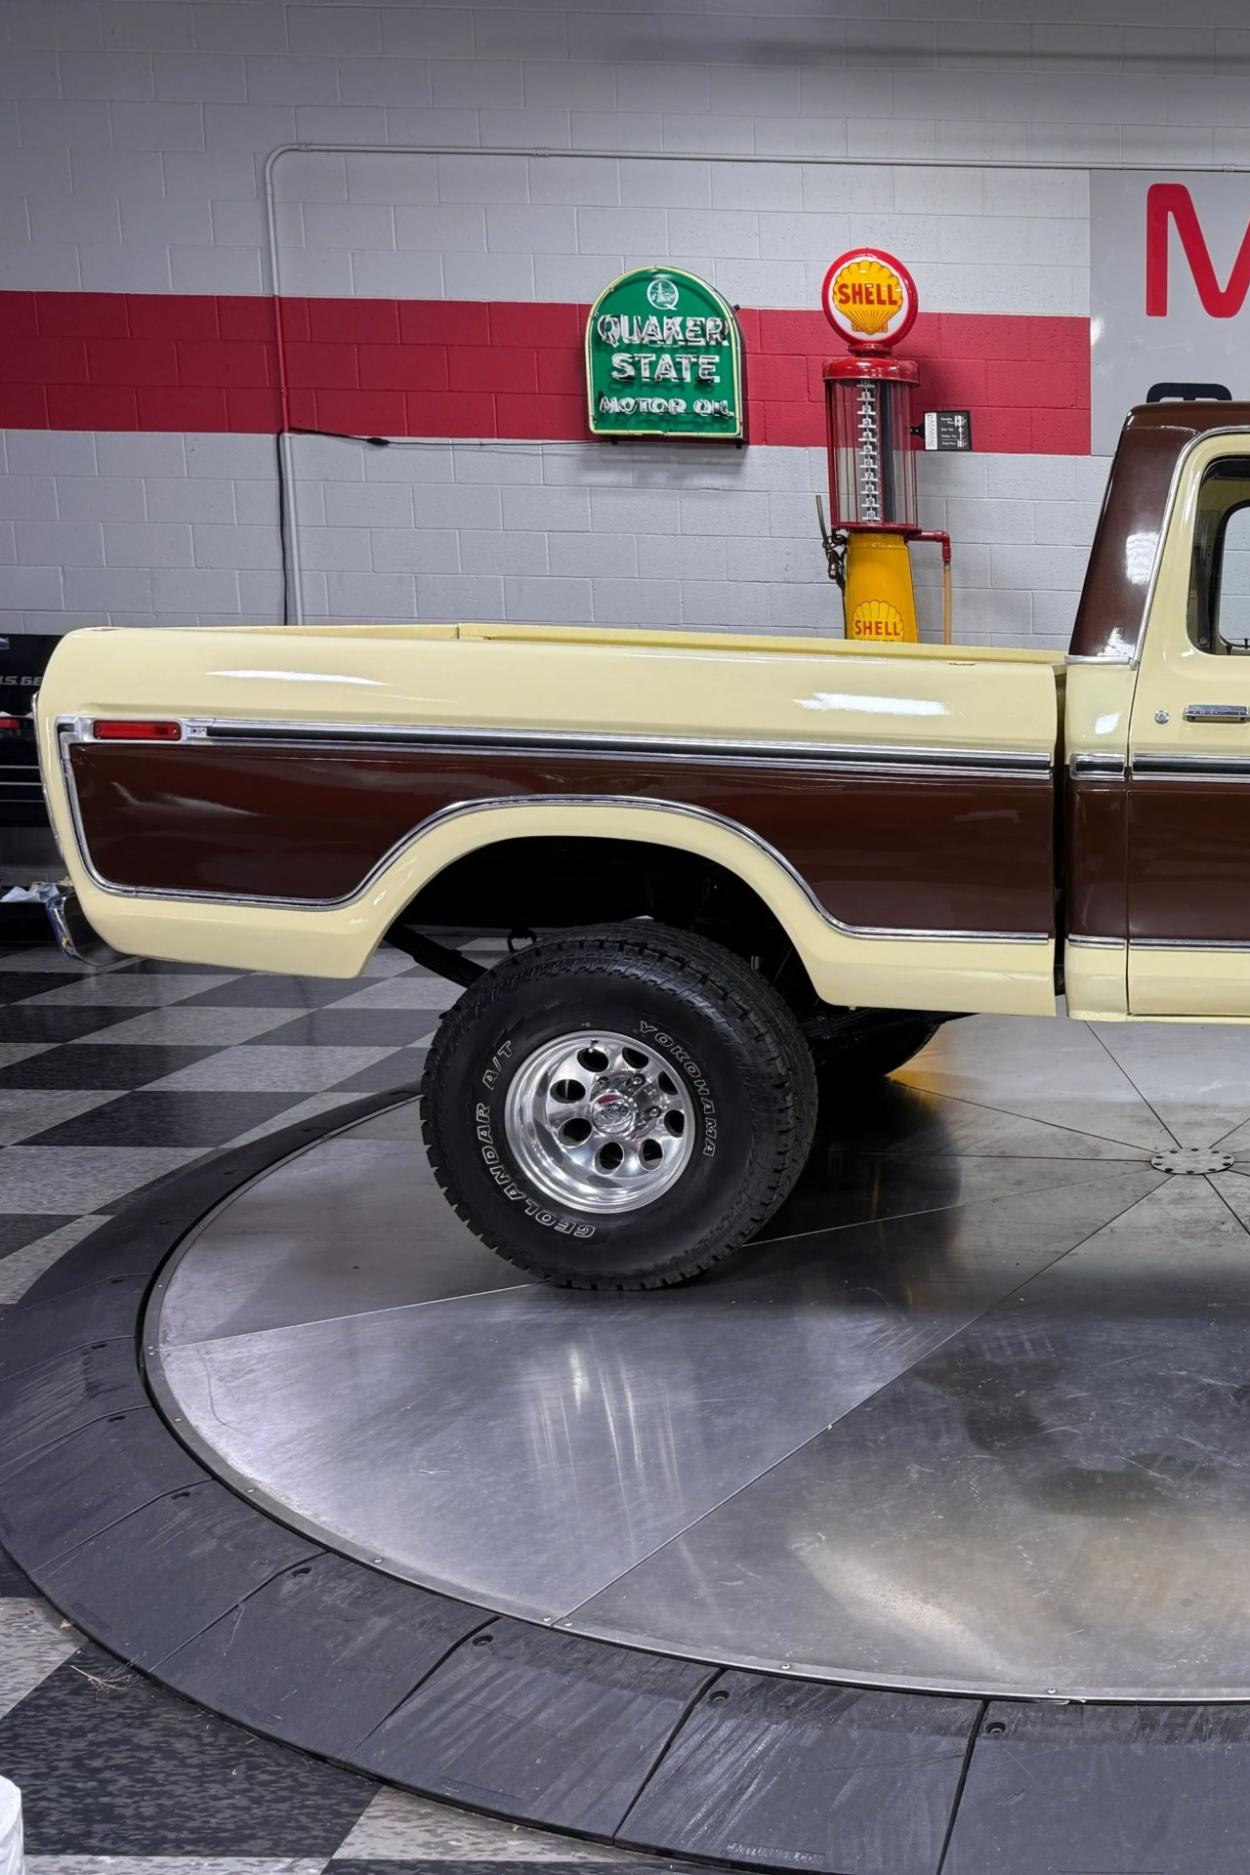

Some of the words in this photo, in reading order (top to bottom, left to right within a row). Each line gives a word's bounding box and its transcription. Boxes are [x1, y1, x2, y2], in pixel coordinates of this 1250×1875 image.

[837, 281, 899, 306] SHELL
[596, 314, 729, 347] QUAKER
[610, 352, 721, 383] STATE
[599, 396, 686, 415] MOTOR
[693, 397, 734, 417] OIL
[854, 619, 900, 636] SHELL
[482, 1040, 514, 1092] A/T
[638, 1020, 719, 1158] YOKOHAMA
[474, 1101, 596, 1239] GEOLANDAR
